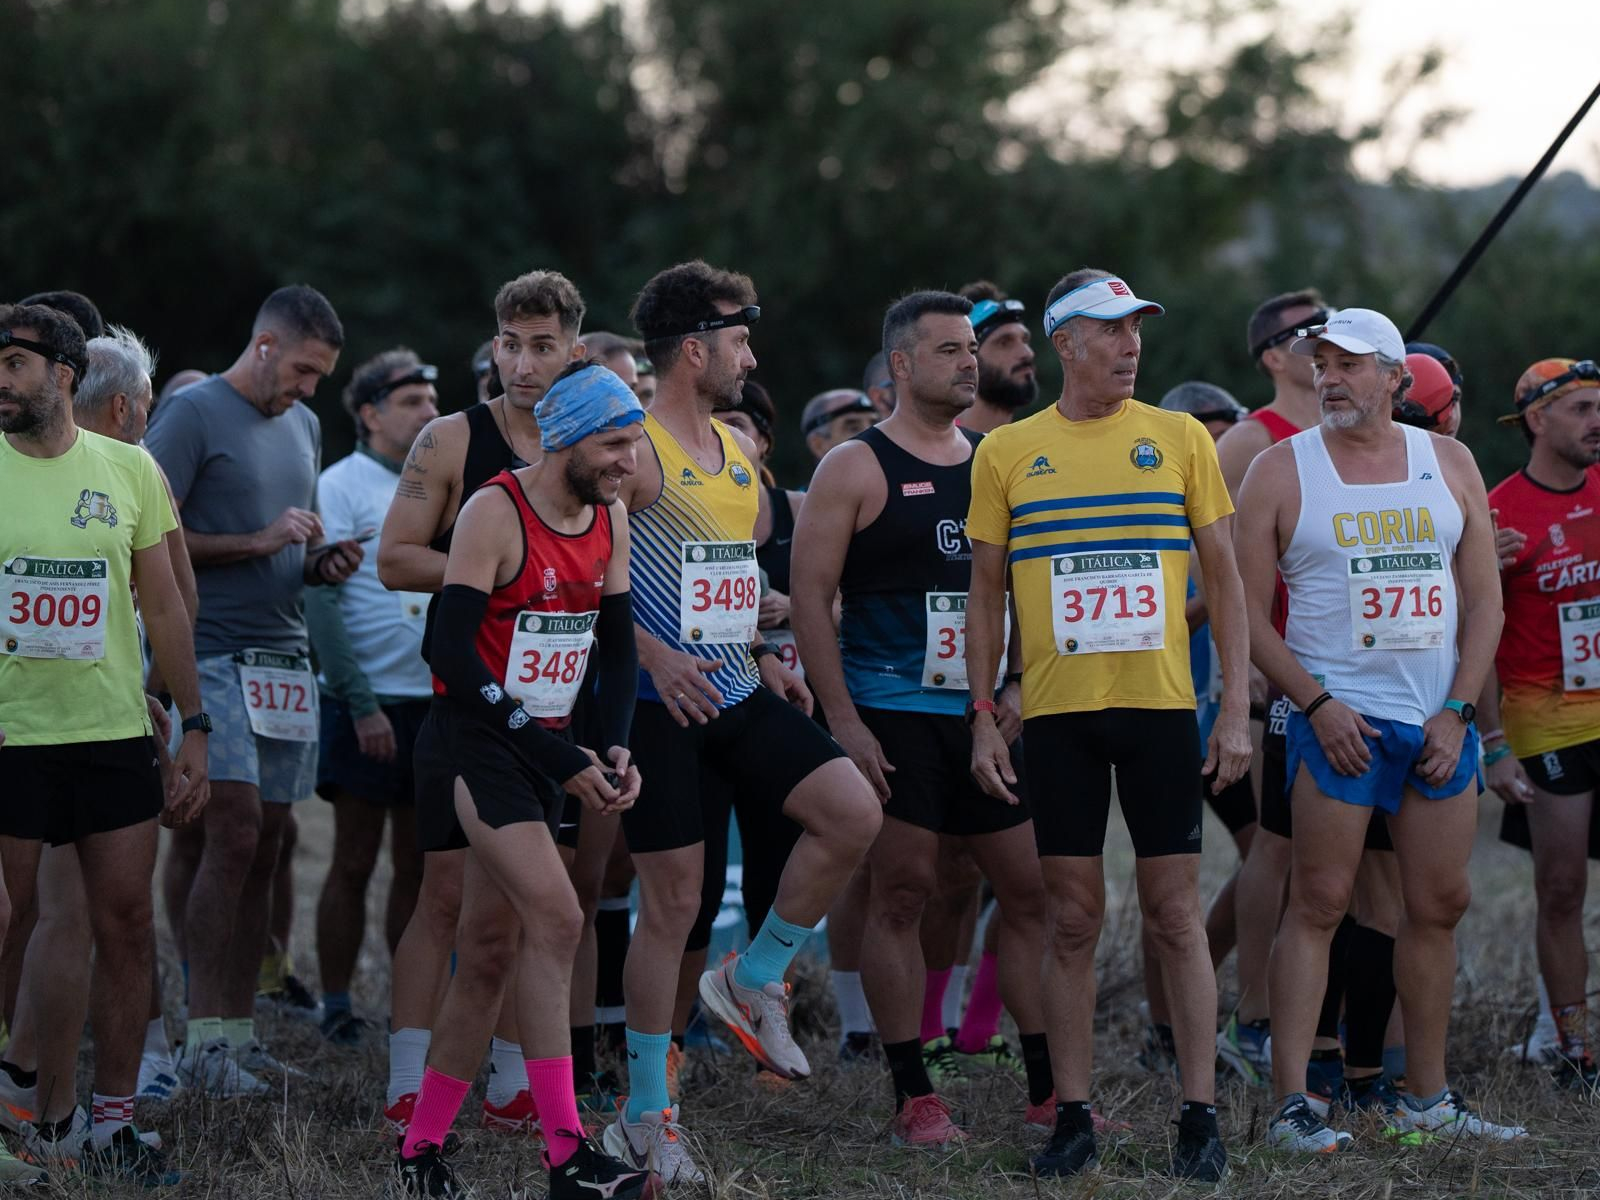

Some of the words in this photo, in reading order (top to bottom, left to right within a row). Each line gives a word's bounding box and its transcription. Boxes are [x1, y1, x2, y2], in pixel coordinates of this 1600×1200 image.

[1332, 507, 1436, 547] CORIA
[34, 561, 84, 575] ITÁLICA
[1081, 555, 1132, 569] ITÁLICA
[1379, 555, 1426, 569] ITÁLICA
[1536, 554, 1583, 573] ATLETISMO
[9, 591, 101, 627] 3009
[691, 576, 756, 612] 3498
[1063, 585, 1157, 623] 3713
[1361, 585, 1443, 619] 3716
[548, 617, 586, 631] ITÁLICA
[247, 679, 309, 713] 3172
